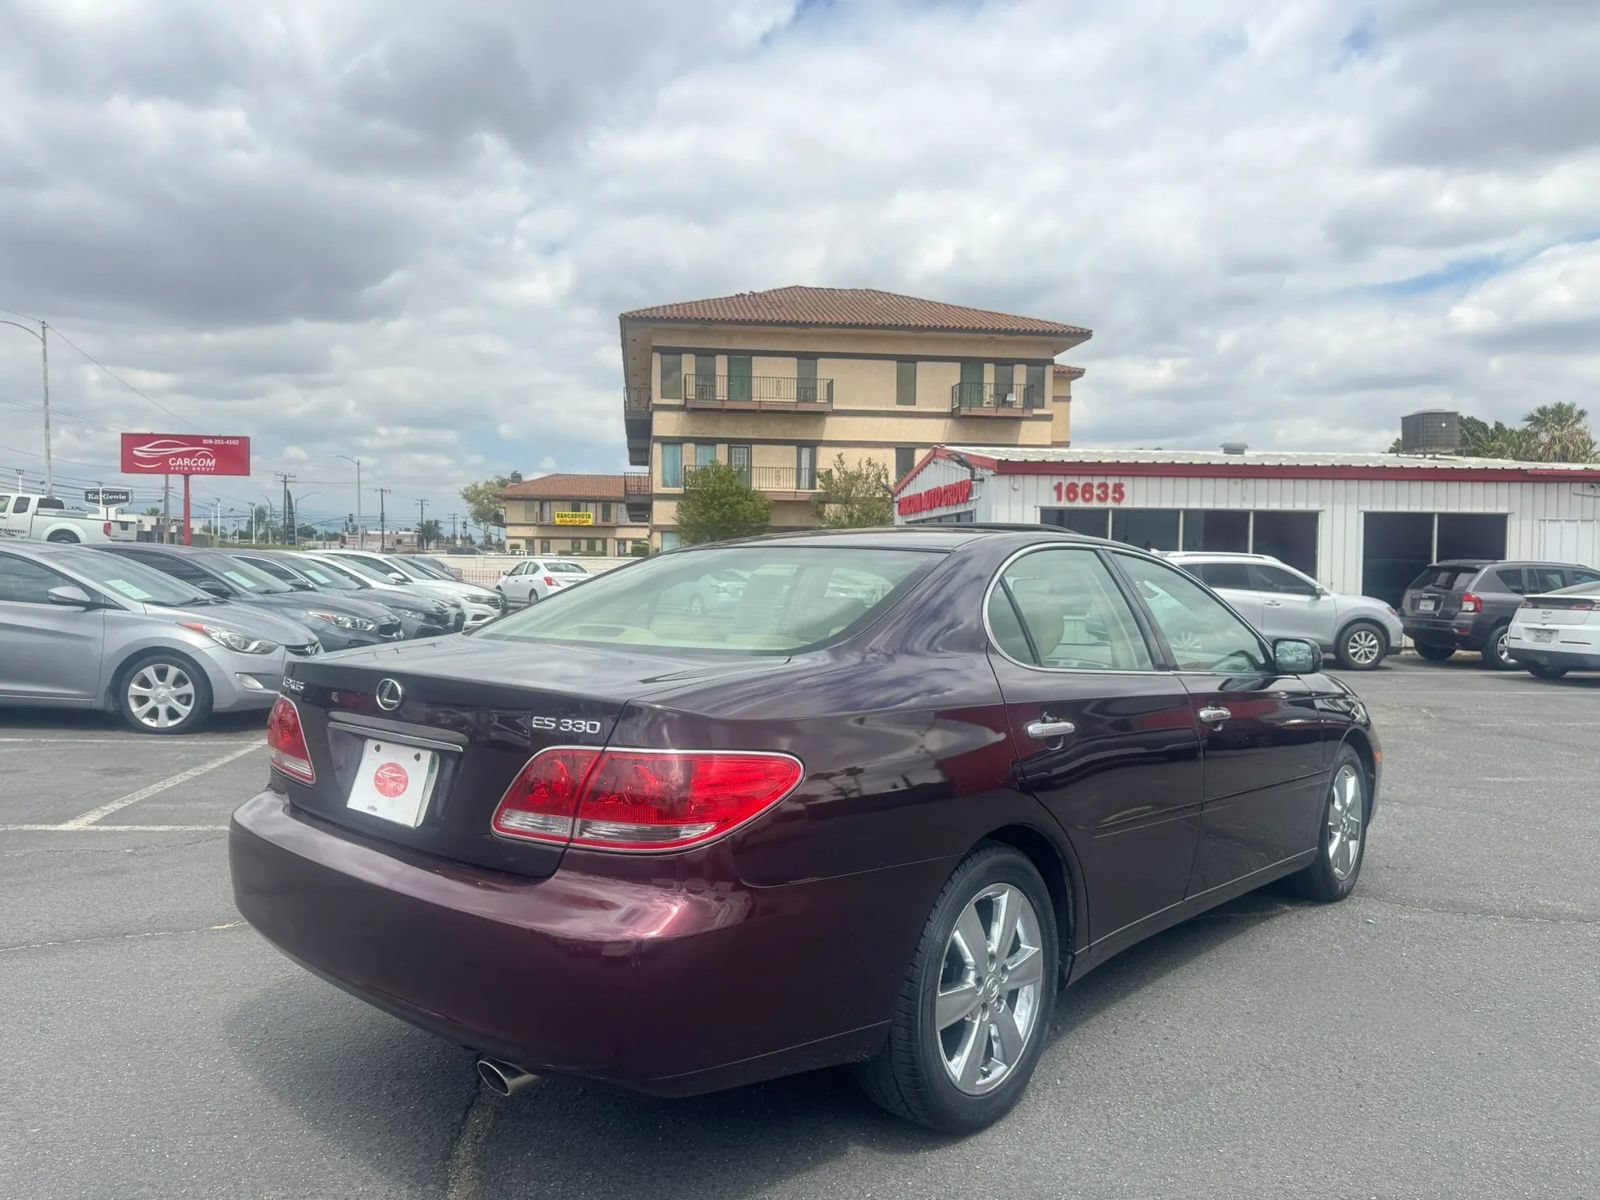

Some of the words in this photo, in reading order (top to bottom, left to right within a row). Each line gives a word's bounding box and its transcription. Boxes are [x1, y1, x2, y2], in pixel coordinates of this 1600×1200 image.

[168, 457, 216, 467] CARCOM
[922, 486, 942, 511] AUTO
[942, 479, 973, 505] GROUP
[1053, 481, 1125, 503] 16635
[532, 716, 556, 730] ES
[559, 718, 601, 734] 330
